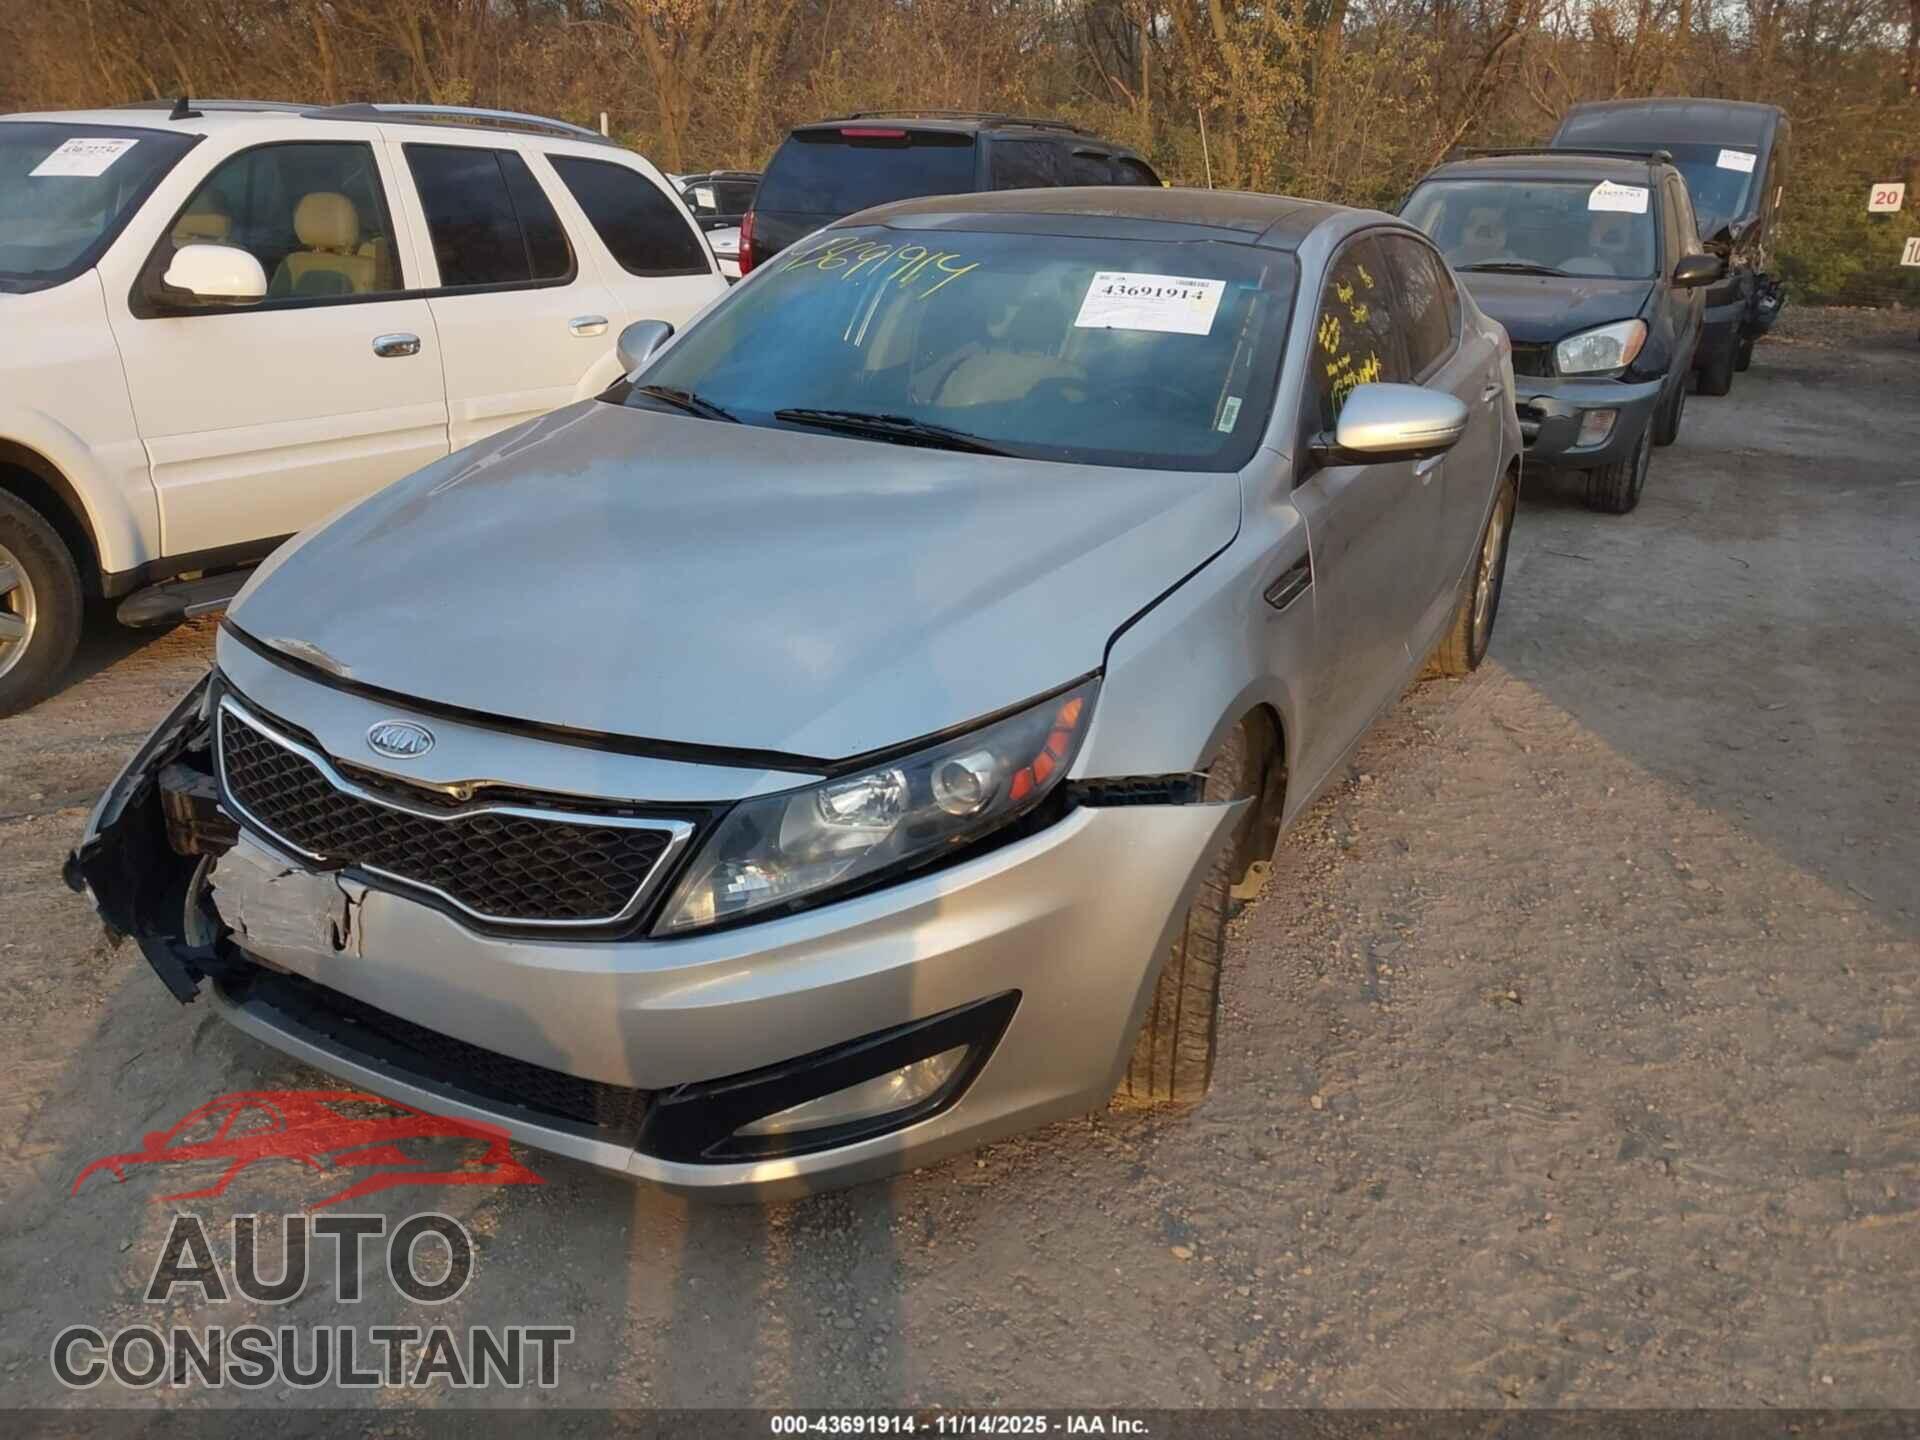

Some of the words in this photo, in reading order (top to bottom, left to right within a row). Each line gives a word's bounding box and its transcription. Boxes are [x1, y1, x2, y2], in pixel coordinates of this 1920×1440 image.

[1875, 191, 1898, 205] 20
[1101, 284, 1205, 300] 43691914
[375, 726, 418, 752] KIA
